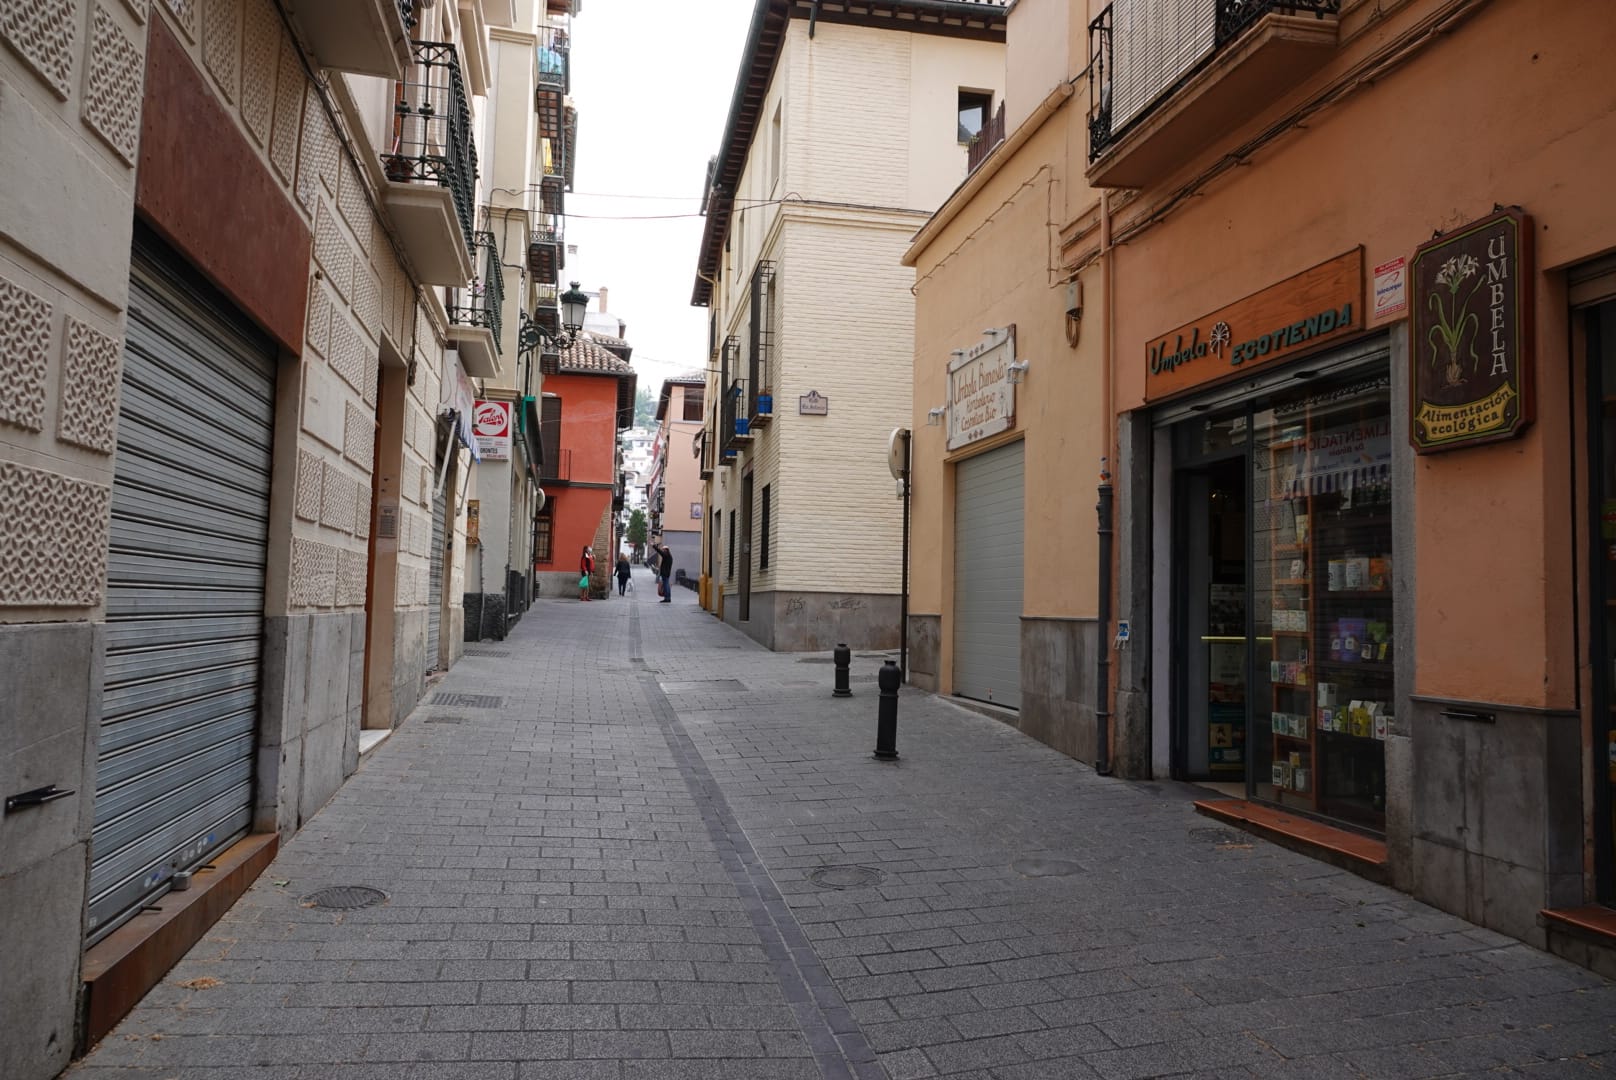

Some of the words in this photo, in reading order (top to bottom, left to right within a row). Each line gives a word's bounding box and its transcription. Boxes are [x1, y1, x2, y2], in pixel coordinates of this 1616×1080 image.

[1487, 231, 1508, 376] UMBELA
[1151, 327, 1206, 375] Umbela
[1231, 303, 1353, 366] ECOTIENDA
[1422, 390, 1510, 422] Alimentación
[1431, 411, 1499, 432] ecológica
